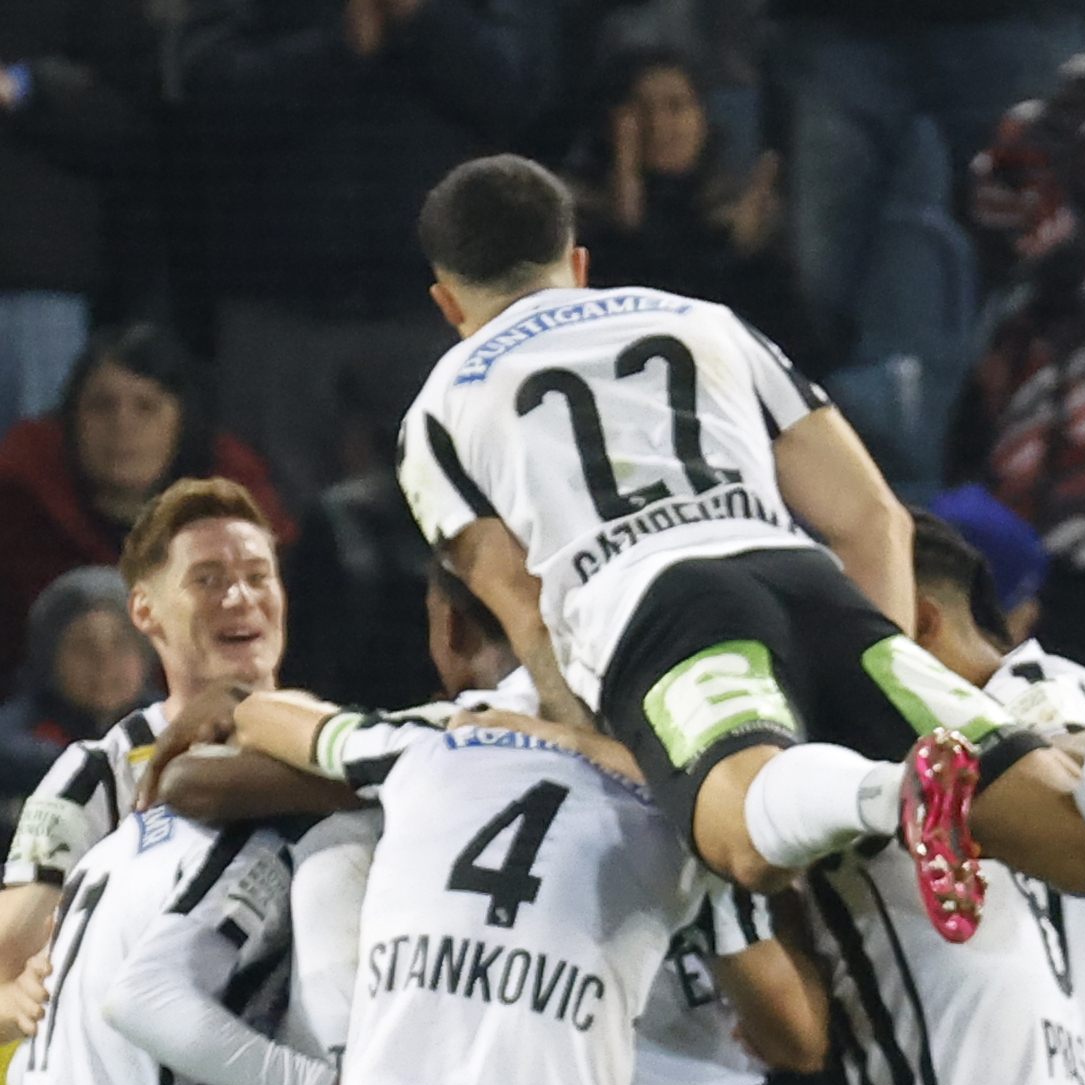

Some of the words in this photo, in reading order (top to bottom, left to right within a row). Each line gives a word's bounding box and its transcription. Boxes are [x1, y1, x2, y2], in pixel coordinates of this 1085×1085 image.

[516, 335, 744, 523] 22
[446, 778, 570, 929] 4
[369, 935, 605, 1031] STANKOVIC
